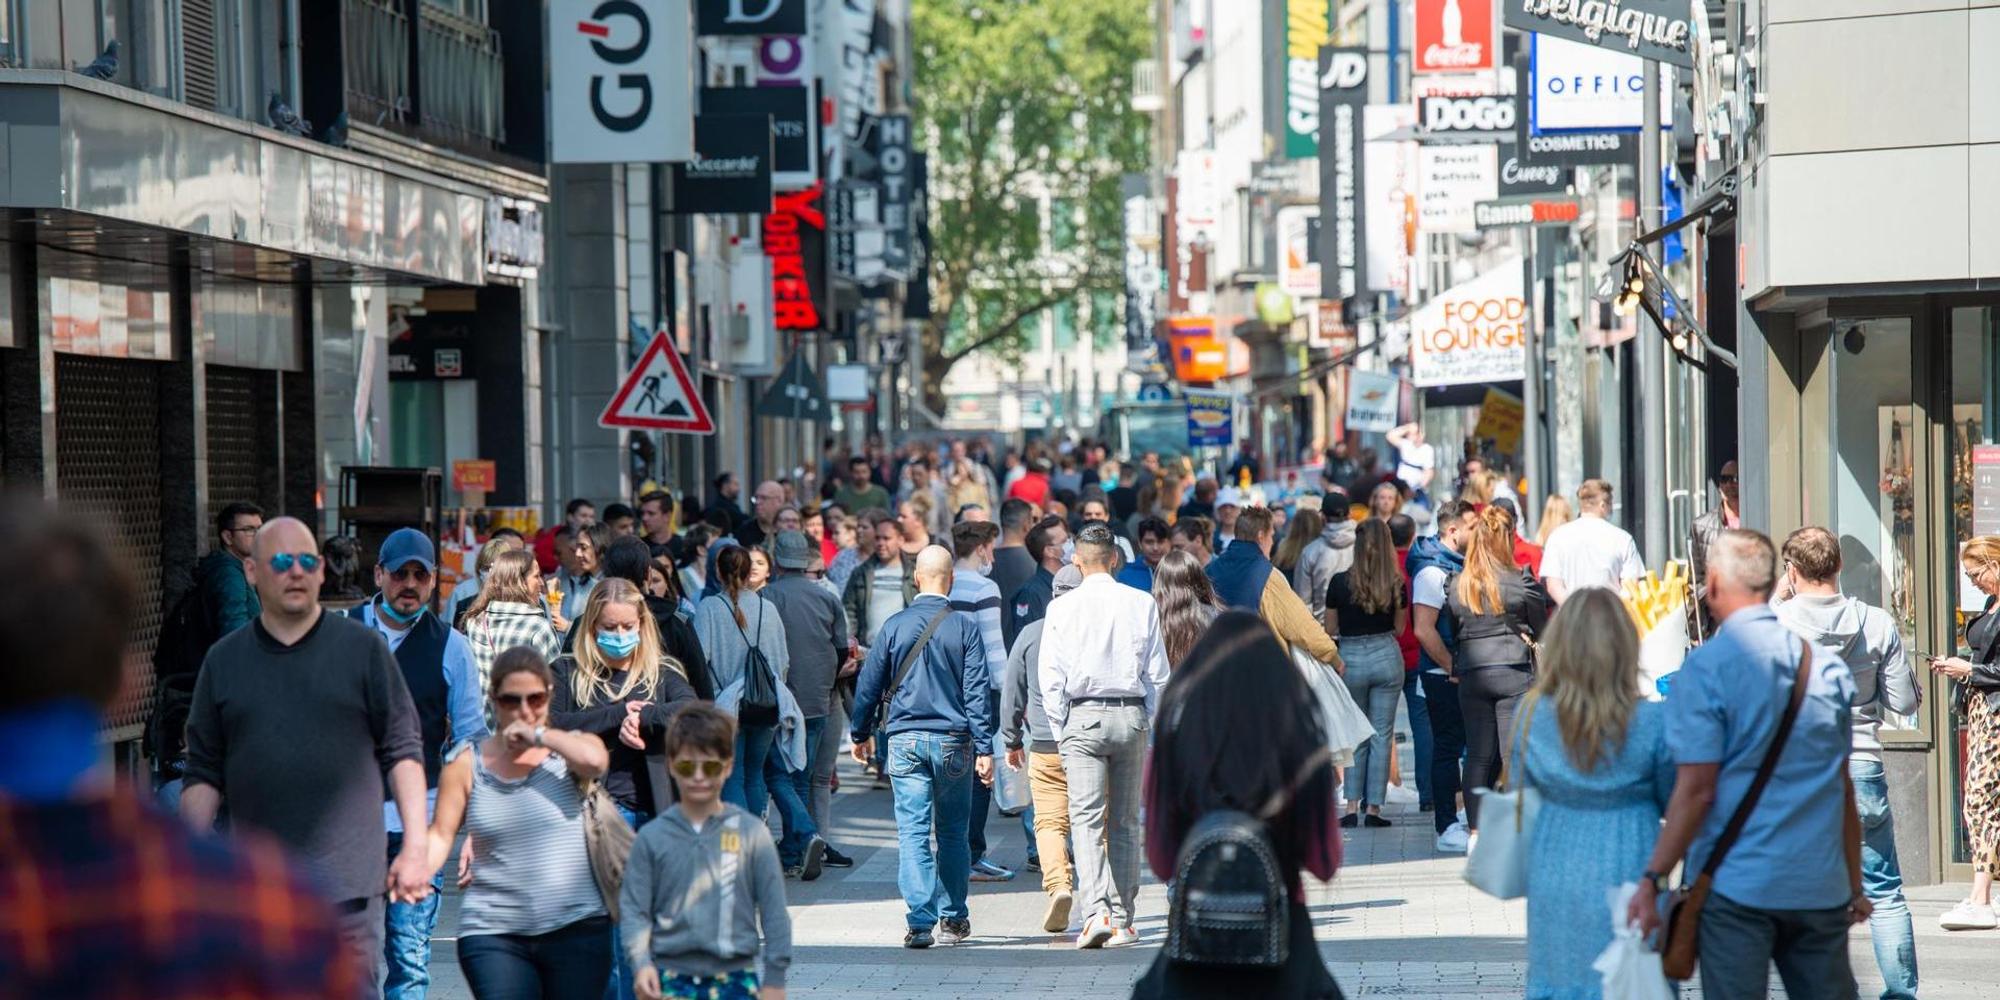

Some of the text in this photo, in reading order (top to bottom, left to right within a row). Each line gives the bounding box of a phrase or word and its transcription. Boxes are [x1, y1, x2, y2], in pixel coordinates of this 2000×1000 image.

[1320, 52, 1367, 89] JD
[1547, 75, 1663, 94] OFFIC
[1529, 135, 1620, 152] COSMETICS
[1444, 298, 1524, 324] FOOD
[1422, 323, 1525, 353] LOUNGE
[721, 831, 740, 852] 10
